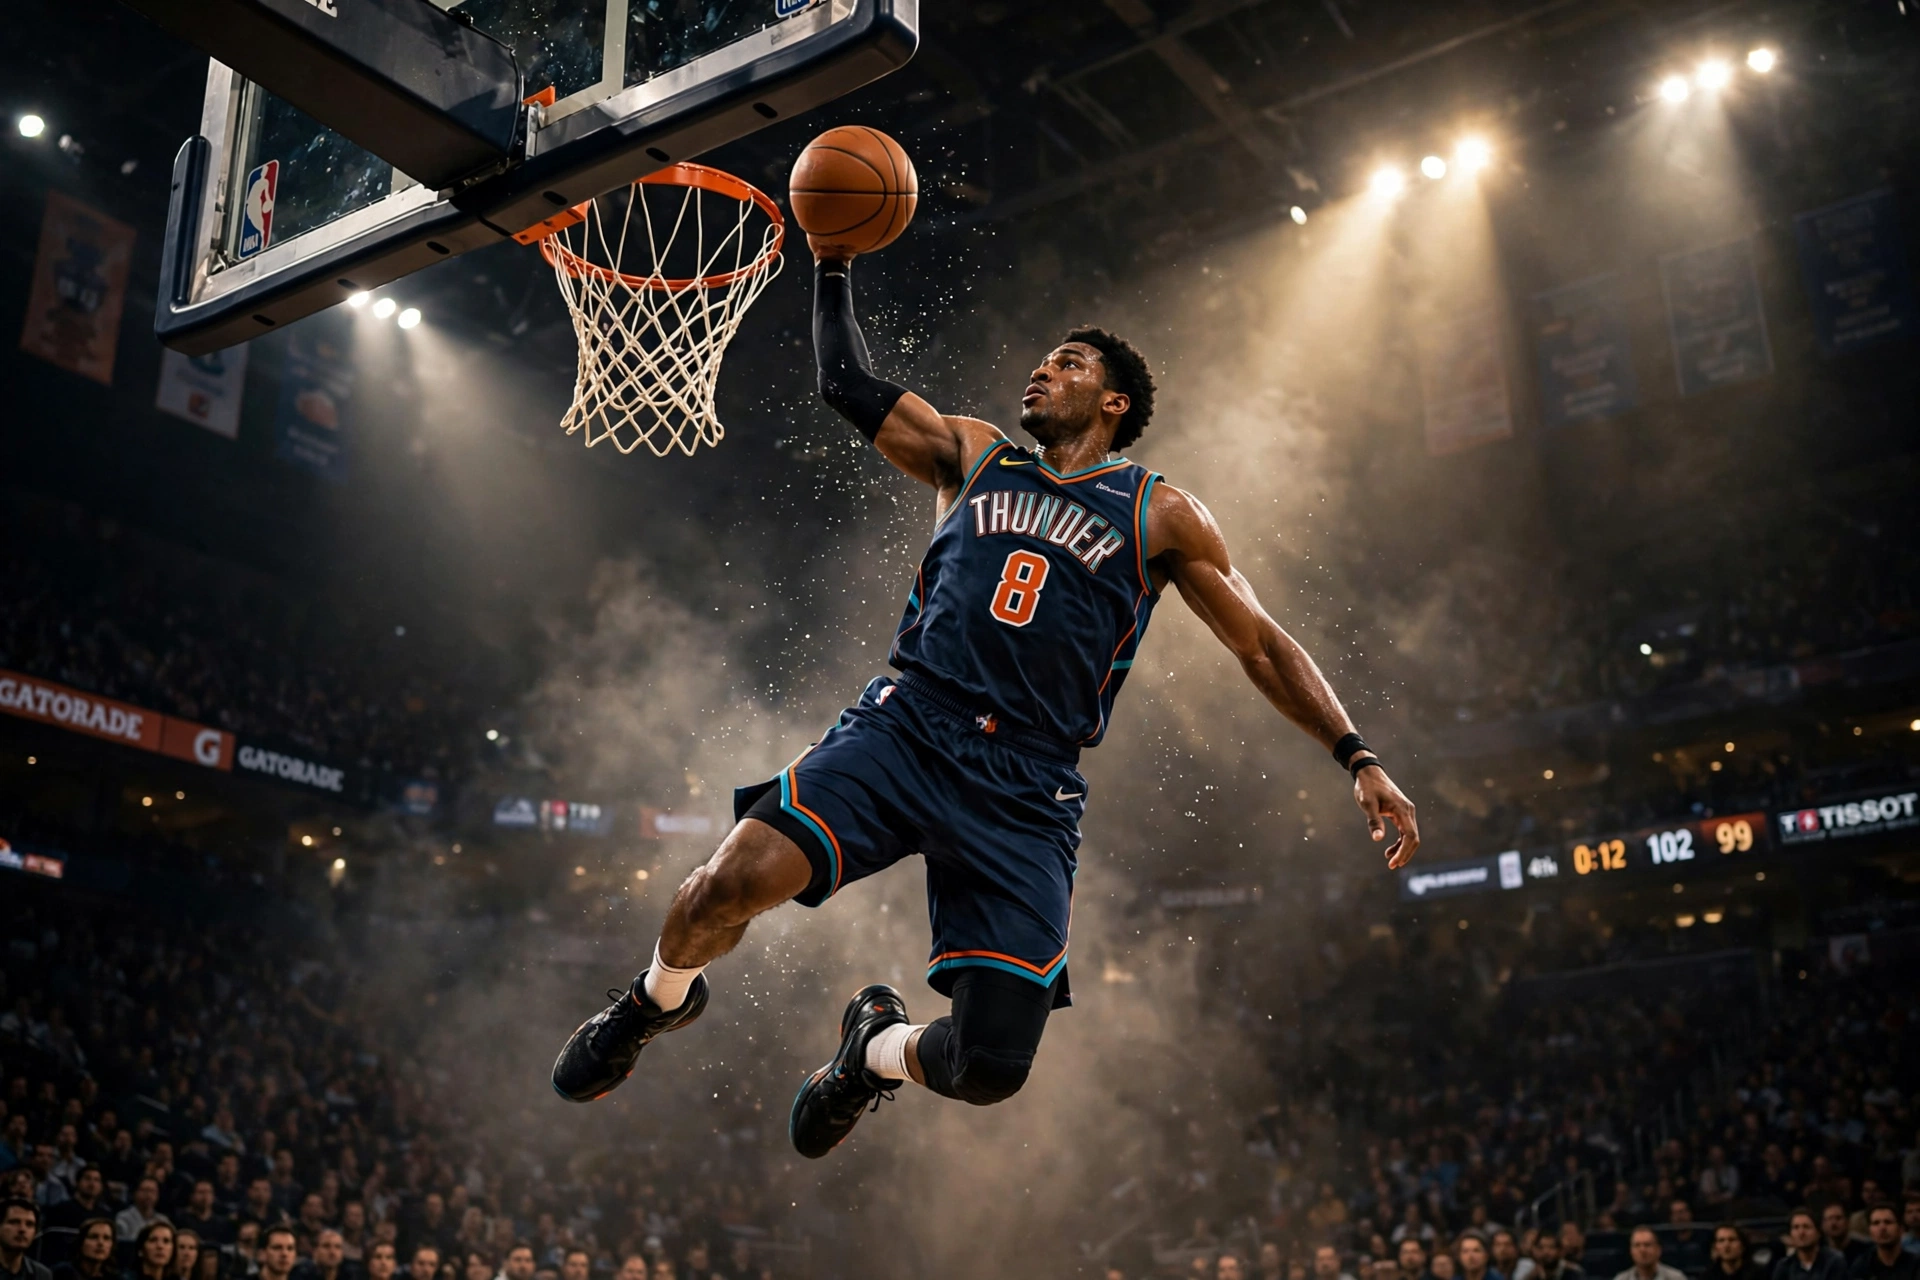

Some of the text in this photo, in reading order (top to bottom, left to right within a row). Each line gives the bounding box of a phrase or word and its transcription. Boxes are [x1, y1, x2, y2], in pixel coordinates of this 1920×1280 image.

[969, 490, 1125, 575] THUNDER
[989, 549, 1050, 627] 8
[0, 679, 143, 740] GATORADE
[194, 729, 221, 766] G
[238, 745, 344, 792] GATORADE
[1819, 792, 1918, 830] TISSOT
[1573, 839, 1627, 875] 0:12
[1647, 828, 1695, 865] 102
[1715, 820, 1753, 855] 99
